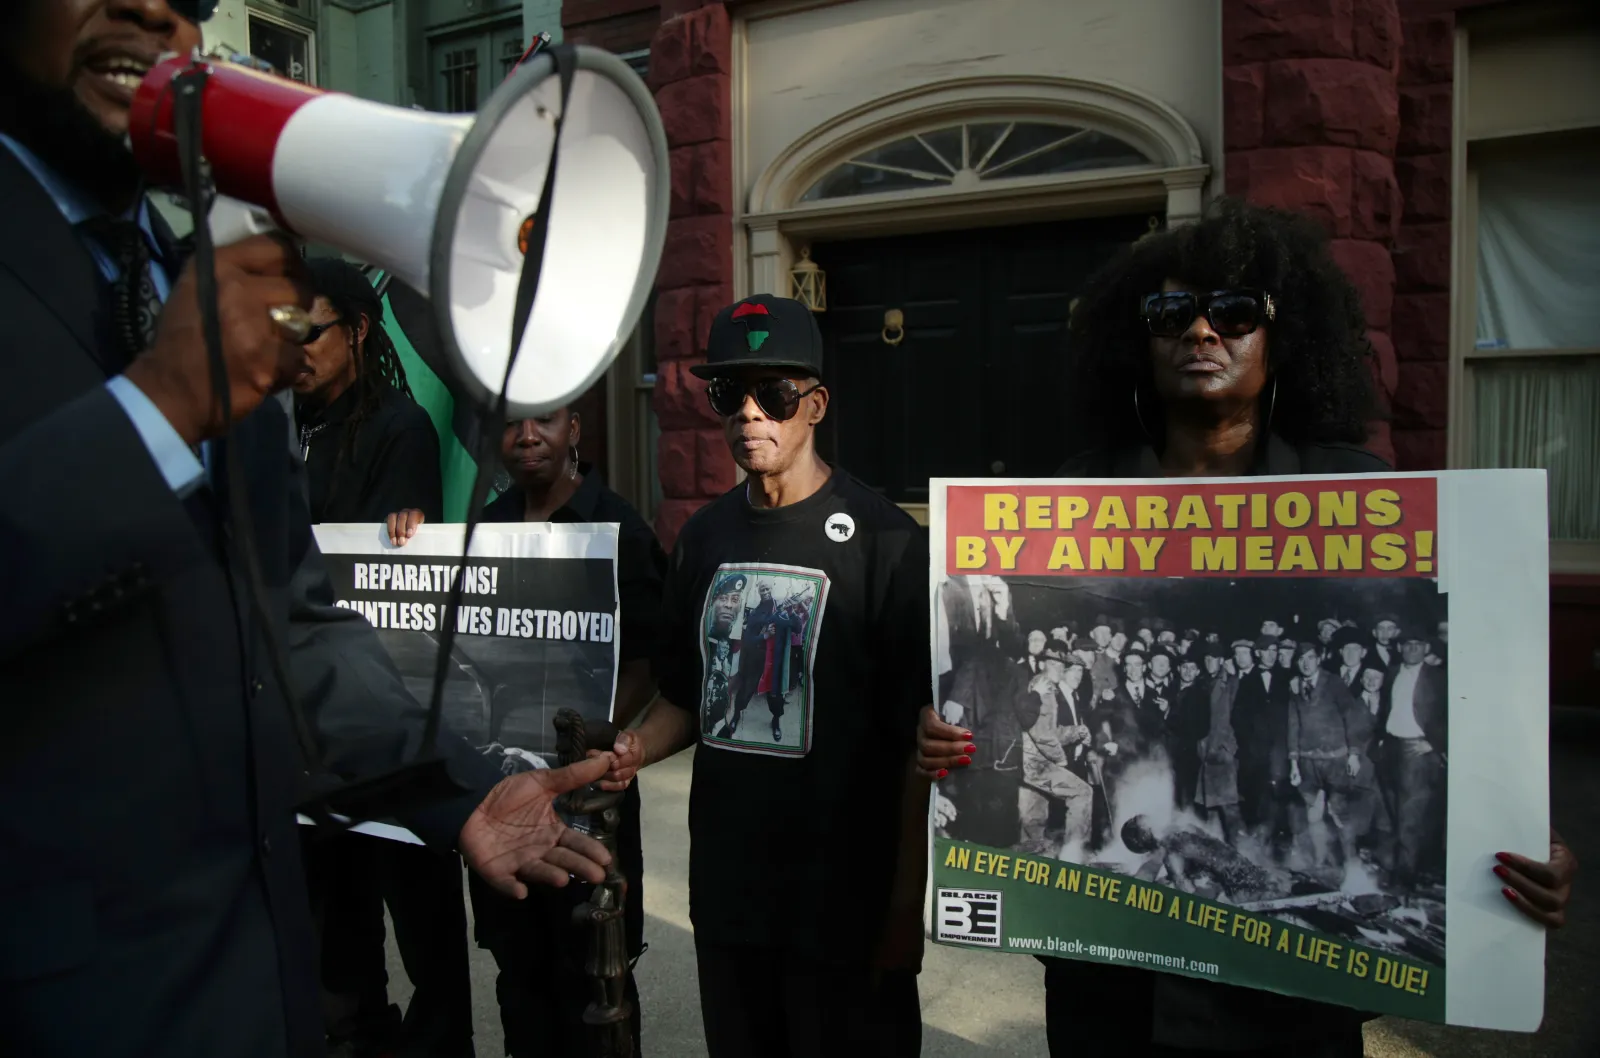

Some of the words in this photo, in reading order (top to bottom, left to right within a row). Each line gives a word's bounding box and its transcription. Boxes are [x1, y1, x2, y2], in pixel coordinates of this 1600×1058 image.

[984, 489, 1402, 531] REPARATIONS
[956, 535, 1025, 570] BY
[1047, 536, 1166, 571] ANY
[1191, 530, 1434, 573] MEANS!
[332, 599, 437, 632] NTLESS
[439, 603, 493, 636] VES
[496, 607, 614, 643] DESTROYED
[941, 891, 998, 900] BLACK
[940, 932, 998, 943] EMPOWERMENT
[944, 846, 970, 870] AN
[974, 851, 1010, 878] EYE
[1013, 858, 1050, 886] FOR
[1055, 867, 1081, 893] AN
[1085, 873, 1121, 902] EYE
[1125, 884, 1164, 914] AND
[1168, 896, 1180, 920] A
[1186, 900, 1228, 933] LIFE
[1231, 913, 1272, 947] FOR
[1276, 928, 1289, 953] A
[1296, 933, 1342, 969] LIFE
[1347, 948, 1370, 978] IS
[1375, 957, 1429, 996] DUE!
[1008, 936, 1219, 975] www.black-empowerment.com
